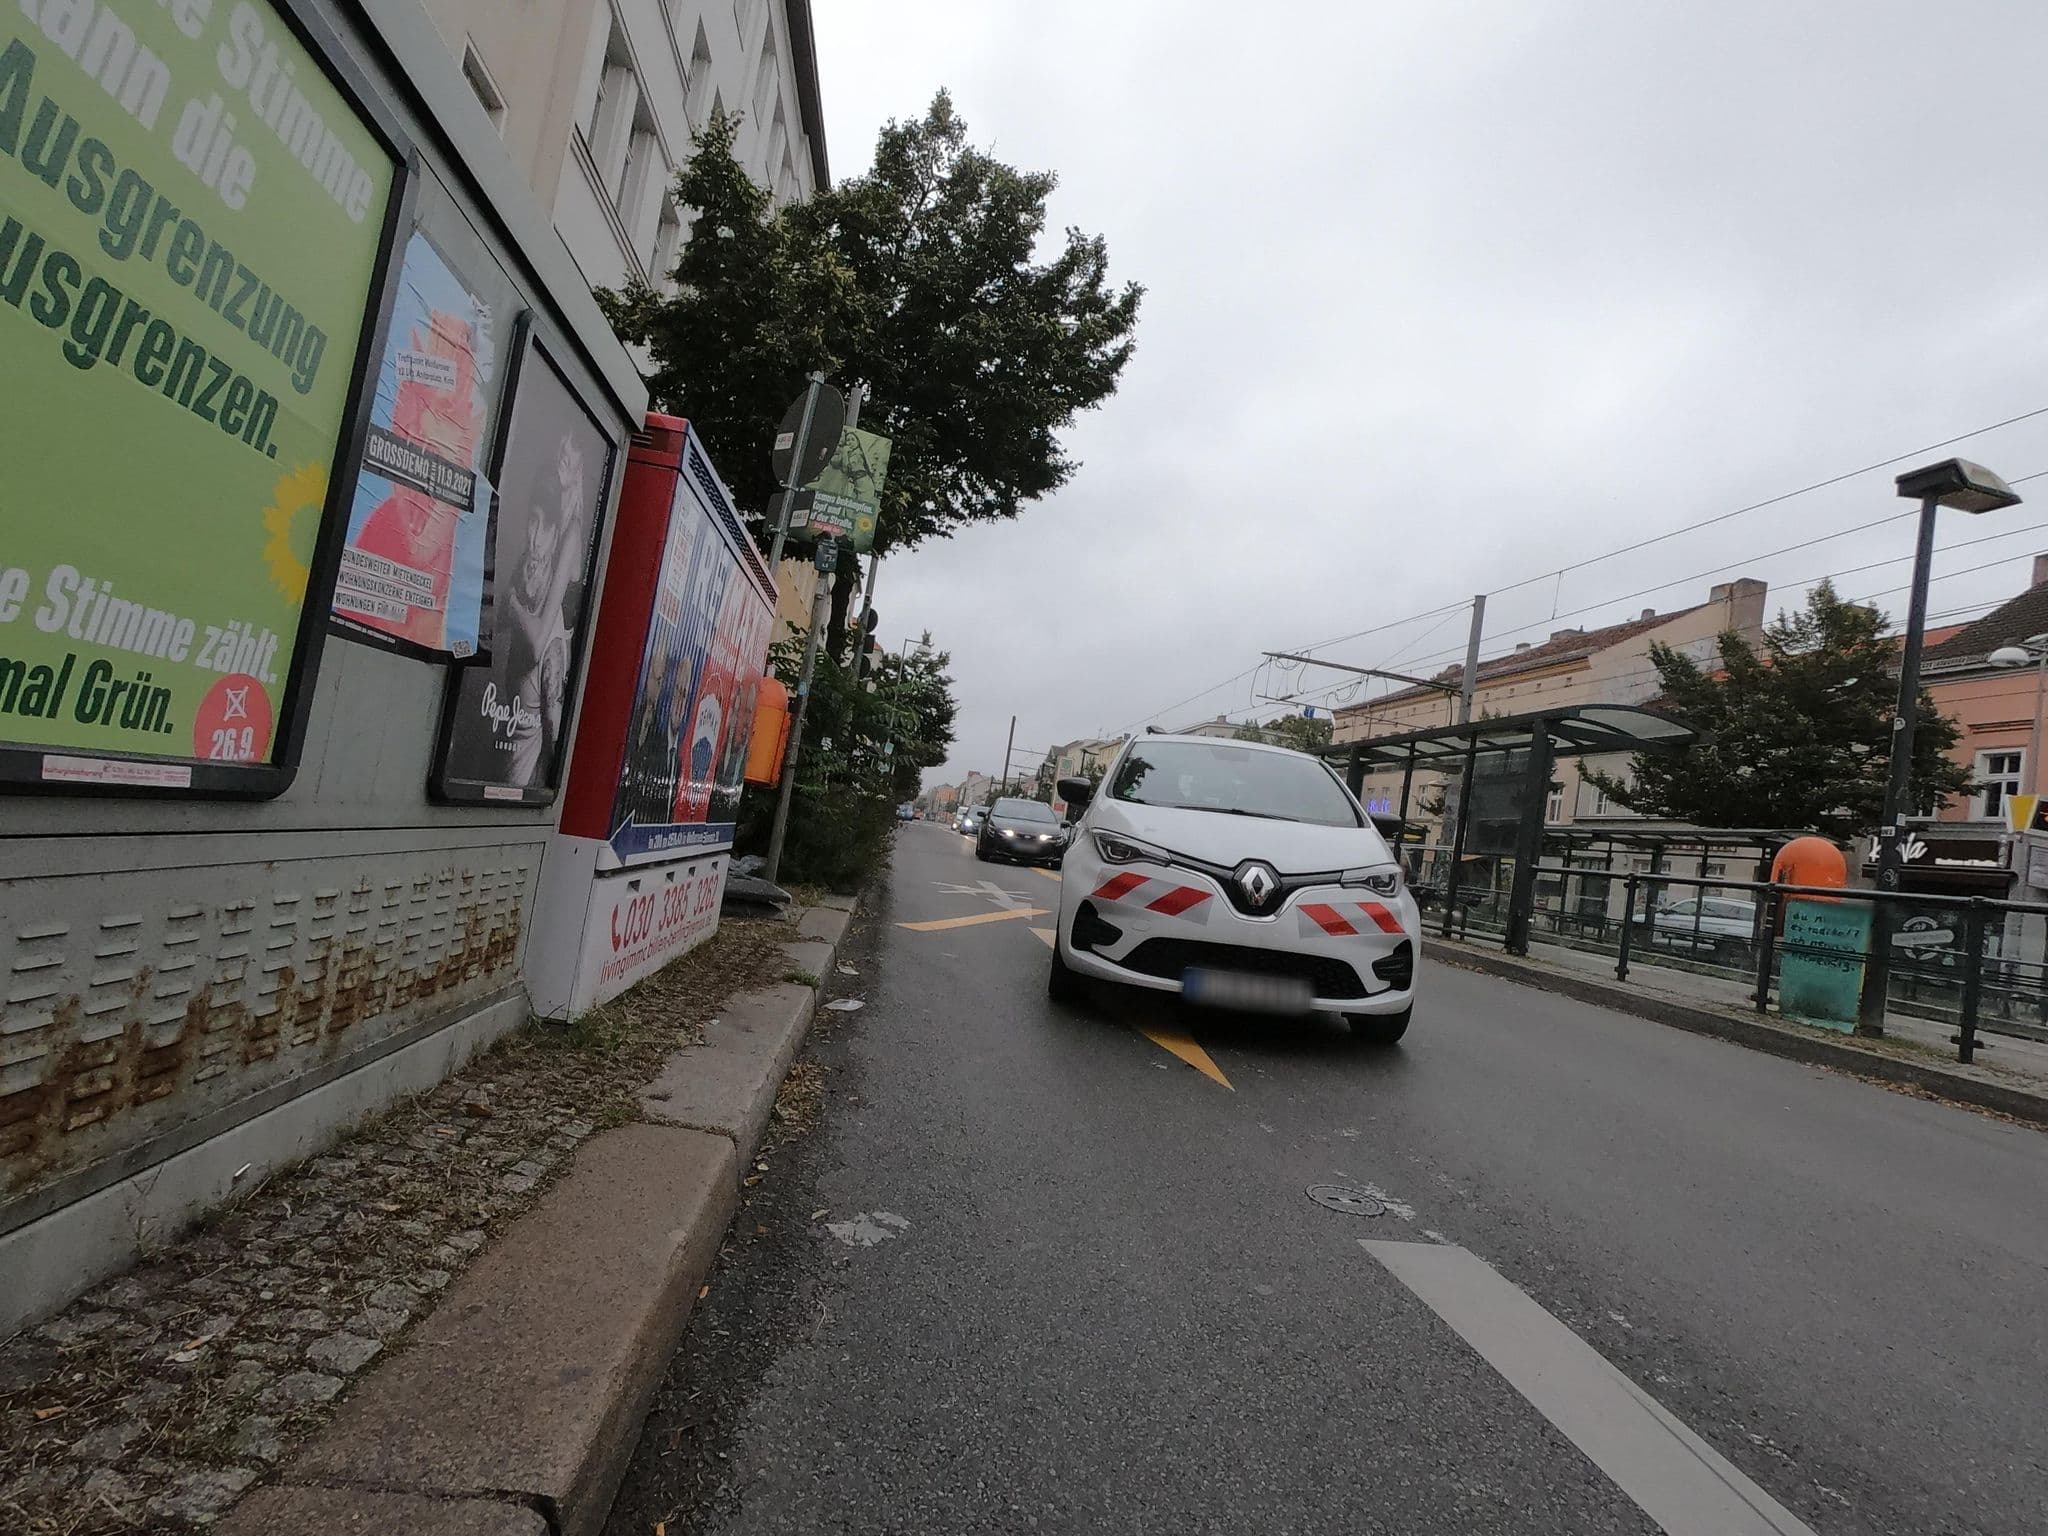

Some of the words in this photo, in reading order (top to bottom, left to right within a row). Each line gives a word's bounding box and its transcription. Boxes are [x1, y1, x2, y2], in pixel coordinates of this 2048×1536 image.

[18, 0, 171, 131] ann
[172, 93, 256, 210] die
[217, 1, 373, 224] Stimme
[0, 37, 328, 395] Ausgrenzung
[369, 434, 429, 480] GROSSDEMO
[437, 464, 472, 497] 11.9.2021
[35, 564, 196, 663] Stimme
[195, 618, 278, 684] zählt.
[74, 659, 174, 734] Grün.
[481, 681, 511, 733] Pepe
[210, 726, 254, 761] 26.9.
[624, 892, 656, 949] 030
[658, 881, 692, 931] 3385
[694, 873, 719, 917] 3262
